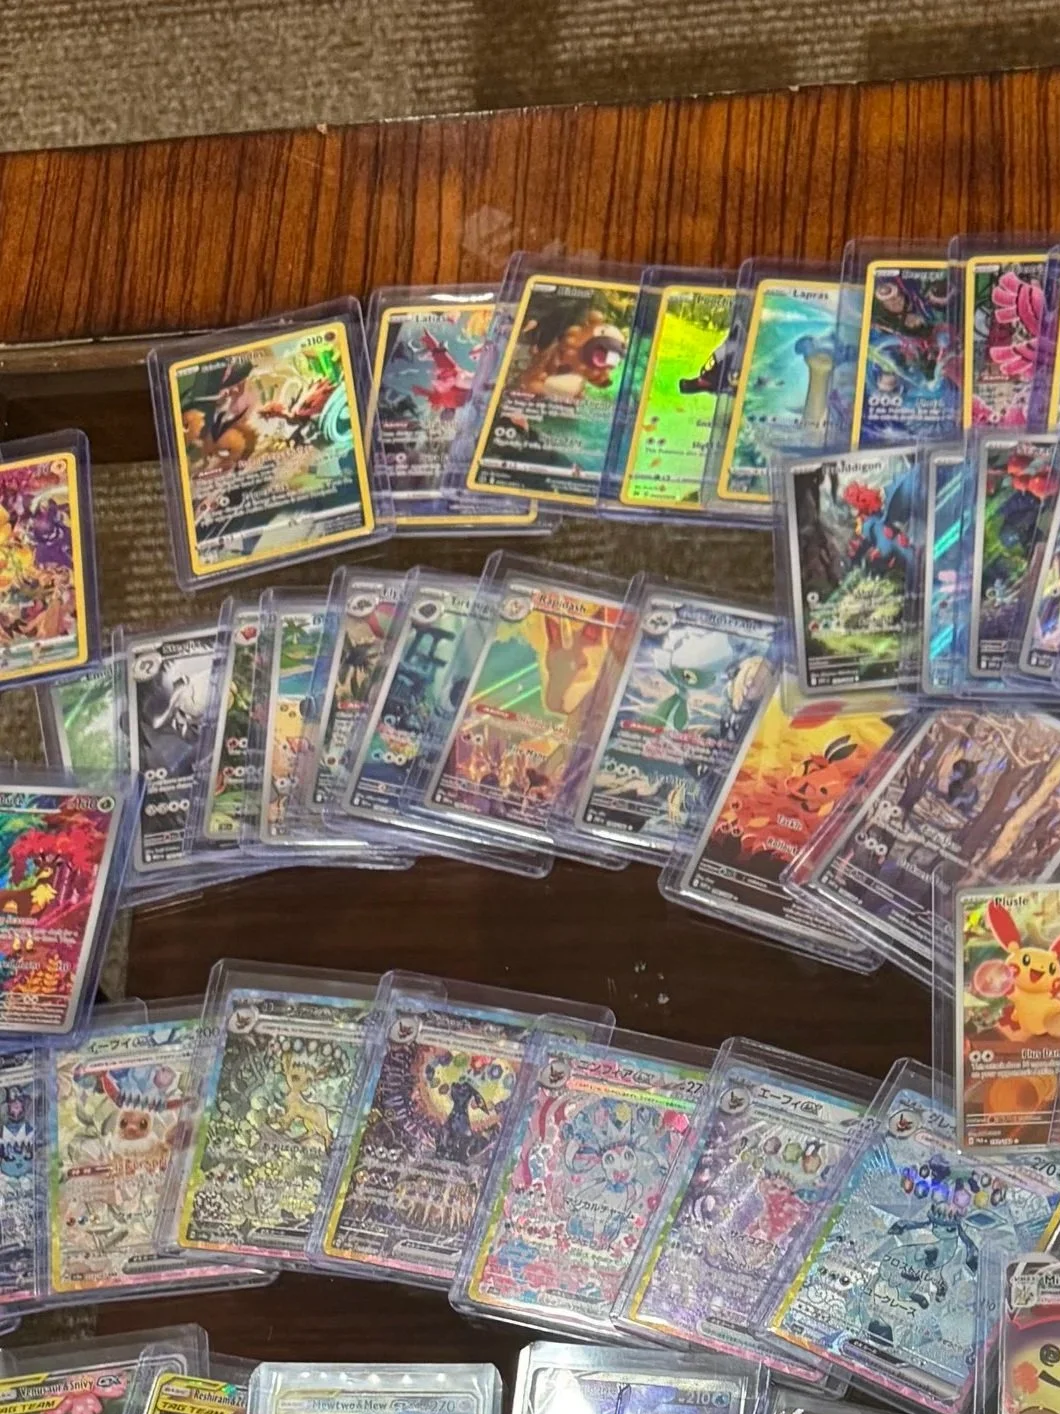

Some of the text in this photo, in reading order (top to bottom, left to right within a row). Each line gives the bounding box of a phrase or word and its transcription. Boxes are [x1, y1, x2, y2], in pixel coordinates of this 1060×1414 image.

[792, 289, 830, 302] Lapras
[991, 895, 1029, 908] Plusle
[1031, 1156, 1058, 1177] 270
[685, 1392, 711, 1405] 210
[20, 1400, 56, 1413] TEAM
[160, 1400, 184, 1412] TAG
[311, 1400, 387, 1412] Mewtwo&Mew
